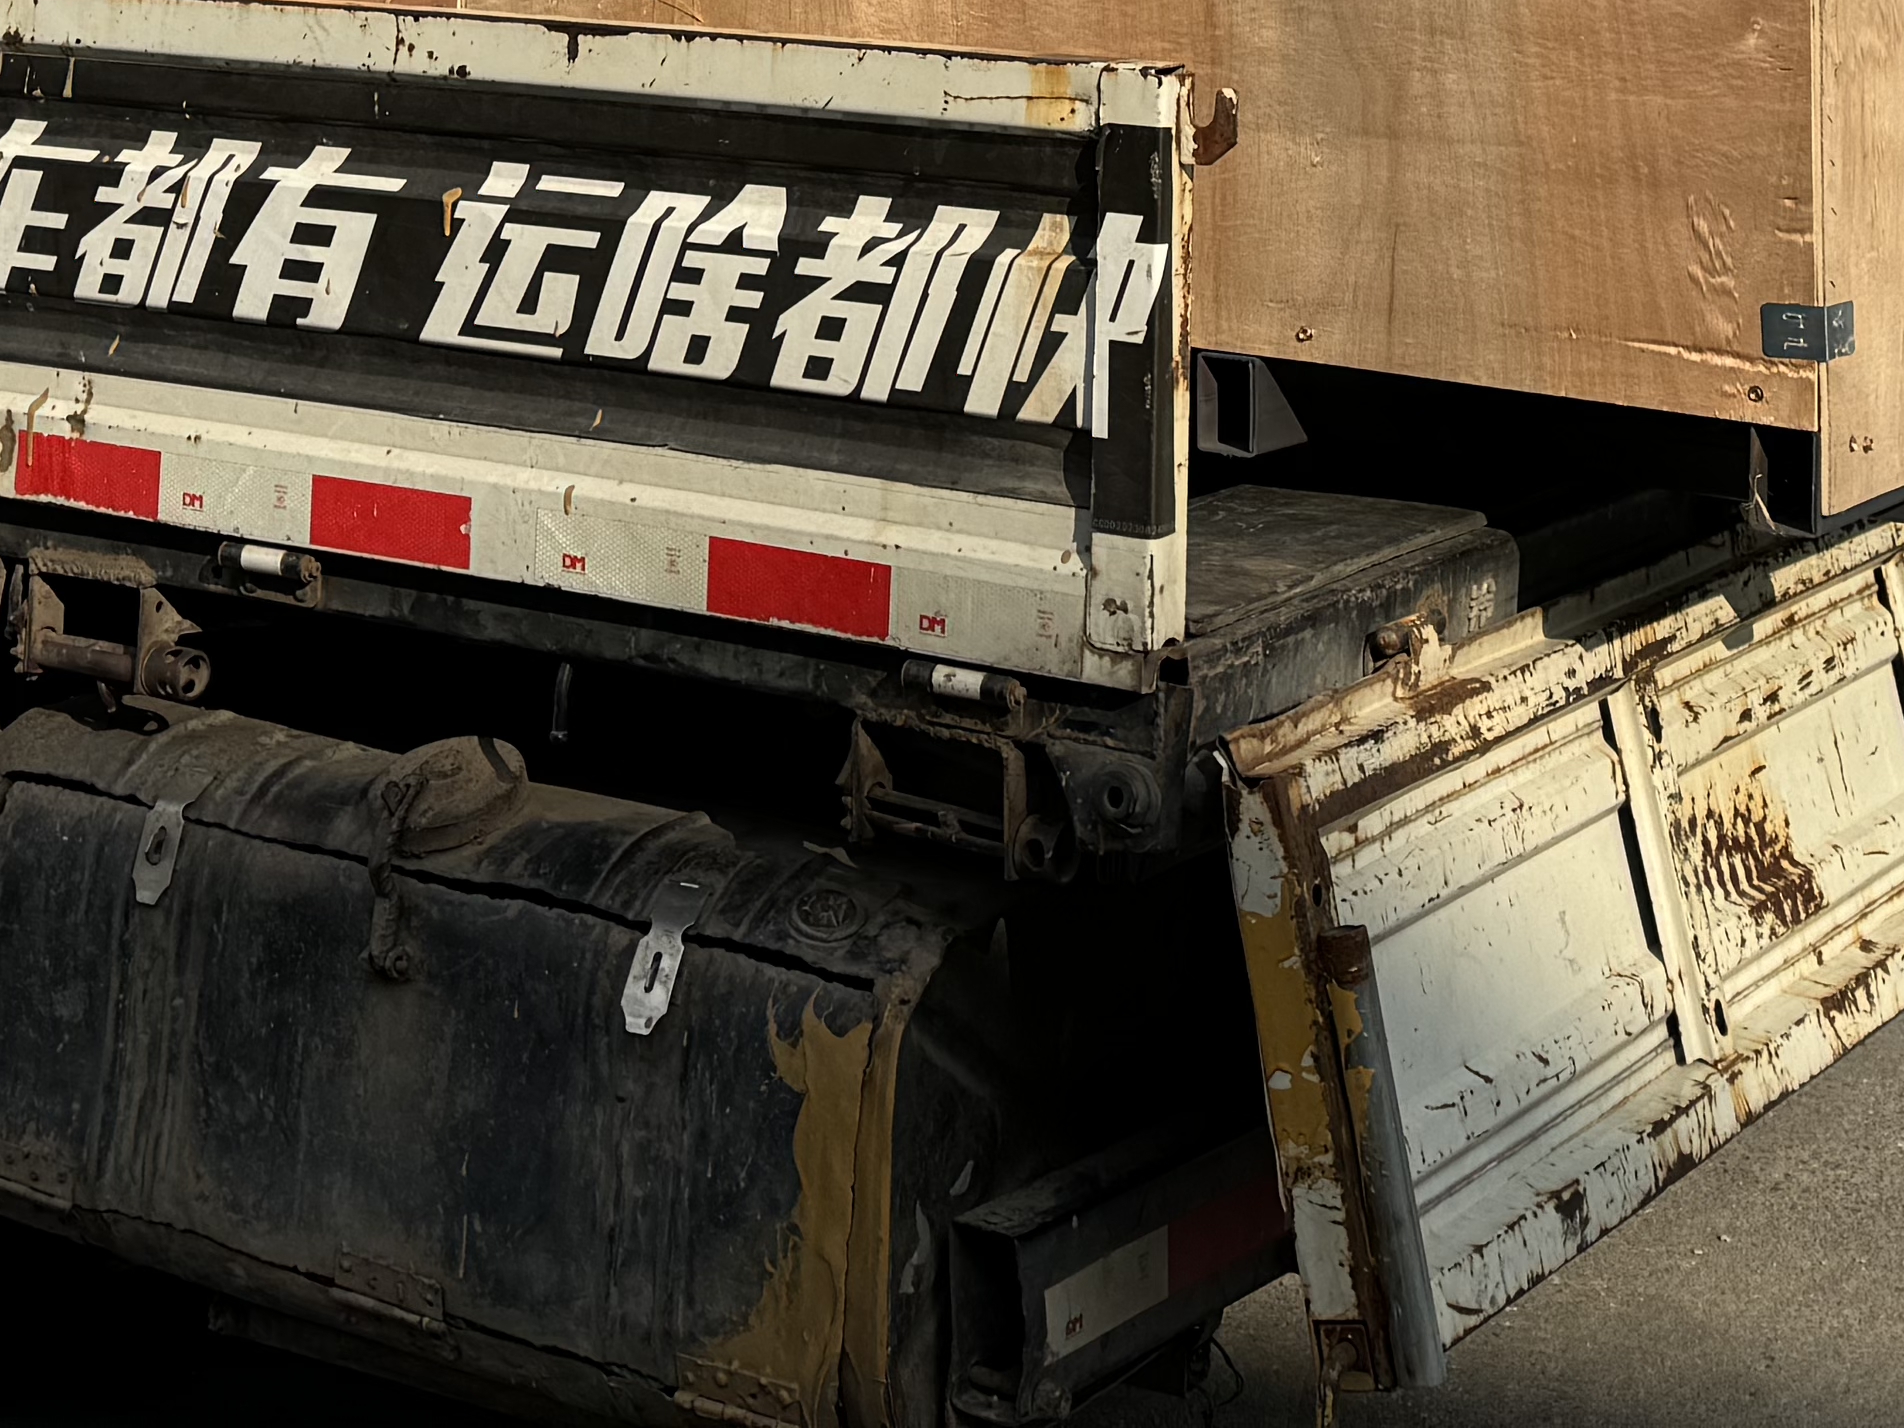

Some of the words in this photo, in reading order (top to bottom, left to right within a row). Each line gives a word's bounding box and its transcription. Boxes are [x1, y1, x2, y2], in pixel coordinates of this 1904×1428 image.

[182, 491, 203, 510] DM
[562, 552, 586, 573] DM
[919, 614, 946, 635] DM
